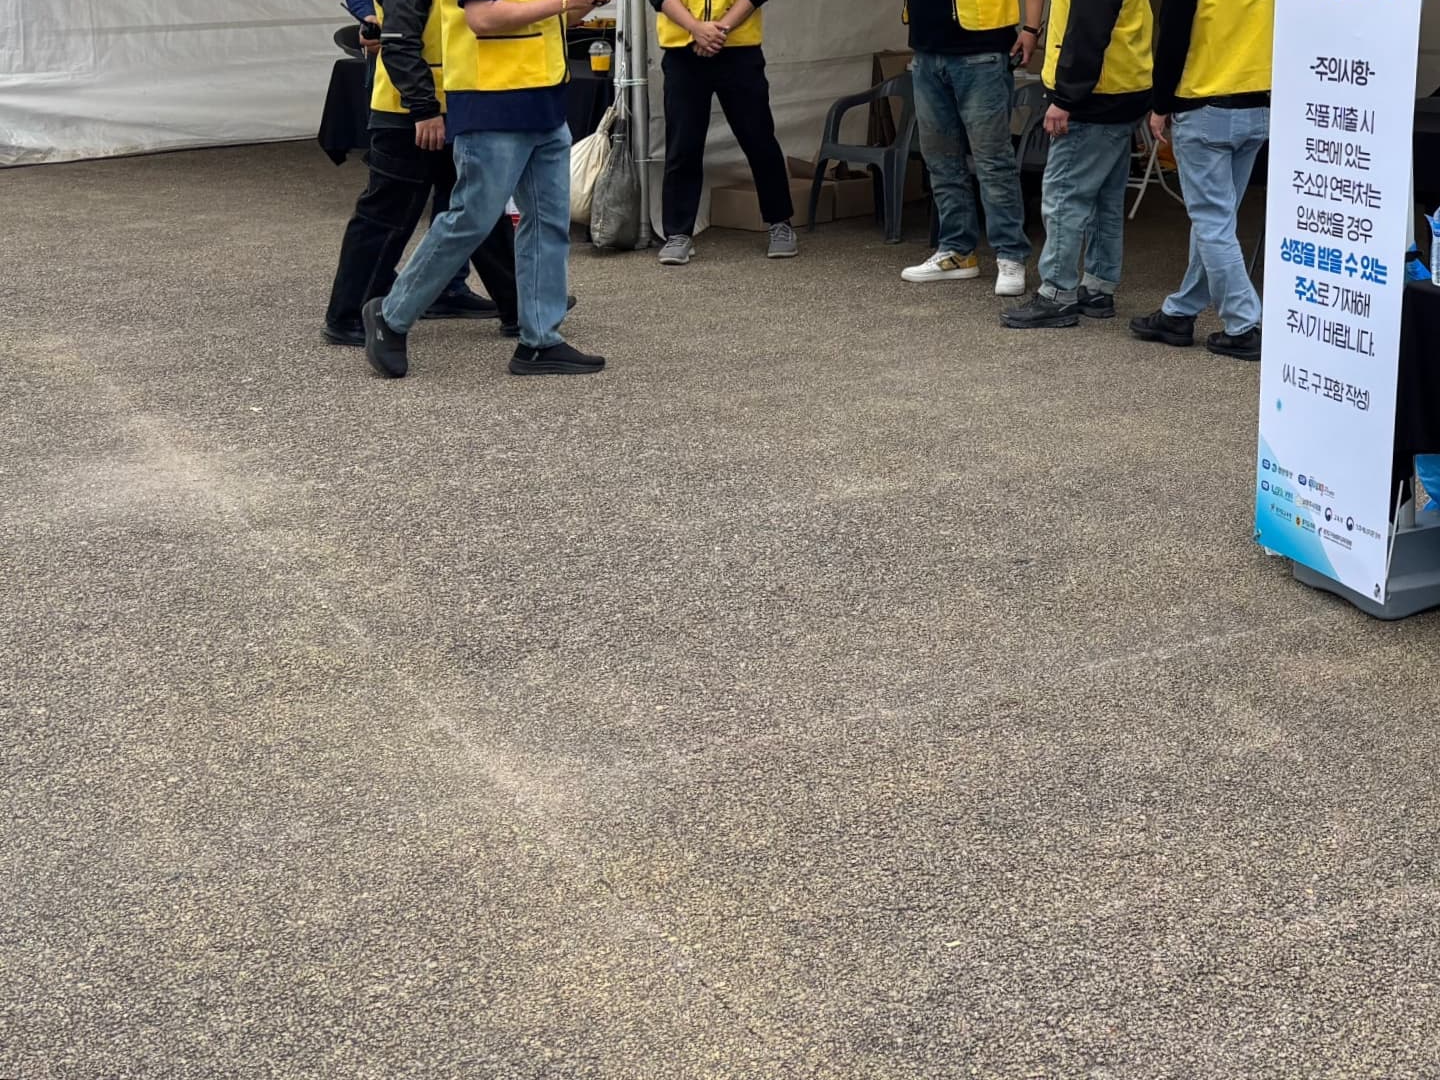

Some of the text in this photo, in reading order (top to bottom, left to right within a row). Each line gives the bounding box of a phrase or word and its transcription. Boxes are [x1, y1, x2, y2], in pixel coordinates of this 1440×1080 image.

[1310, 56, 1376, 86] -주의사항-
[1305, 102, 1375, 134] 작품 제출 시
[1305, 137, 1371, 170] 뒷면에 있는
[1292, 170, 1382, 209] 주소와 연락처는
[1297, 205, 1373, 243] 입상했을 경우
[1280, 237, 1388, 285] 상장을 받을 수 있는
[1294, 275, 1371, 318] 주소로 기재해
[1286, 309, 1375, 357] 주시기 바랍니다.
[1323, 376, 1344, 402] 포함
